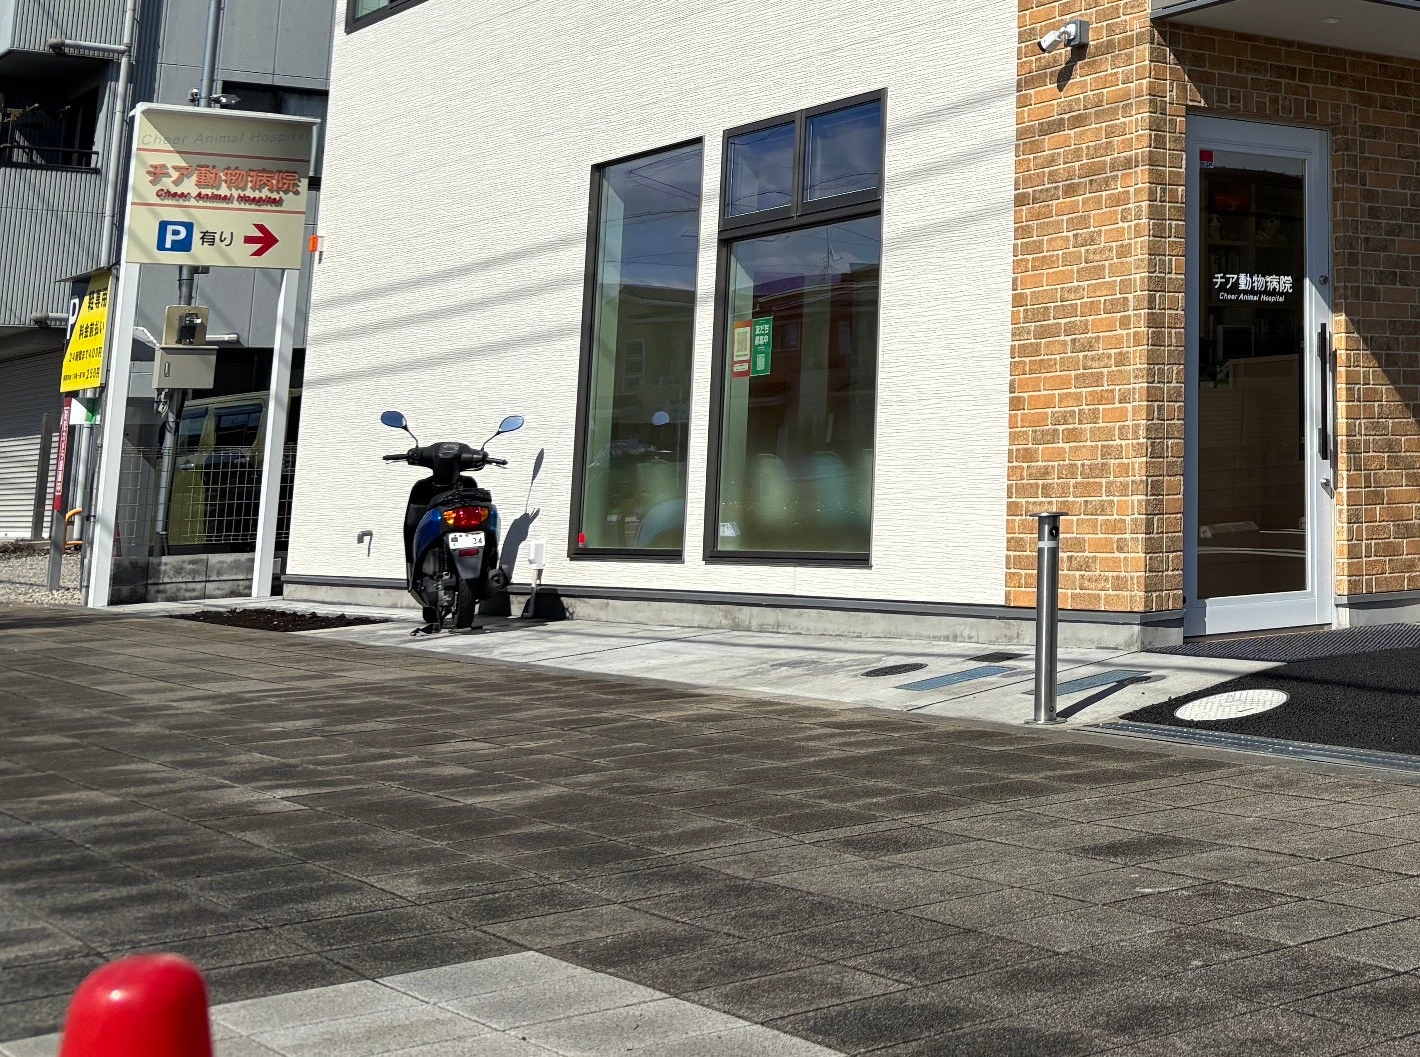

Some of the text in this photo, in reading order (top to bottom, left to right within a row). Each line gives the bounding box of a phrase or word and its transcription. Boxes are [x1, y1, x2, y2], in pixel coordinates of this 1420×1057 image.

[146, 163, 301, 193] チア動物病院
[156, 188, 283, 207] Cheer Animal Hospital
[165, 225, 234, 249] P 有り
[1212, 273, 1293, 293] チア動物病院
[1219, 292, 1285, 303] Cheer Animal Hospital
